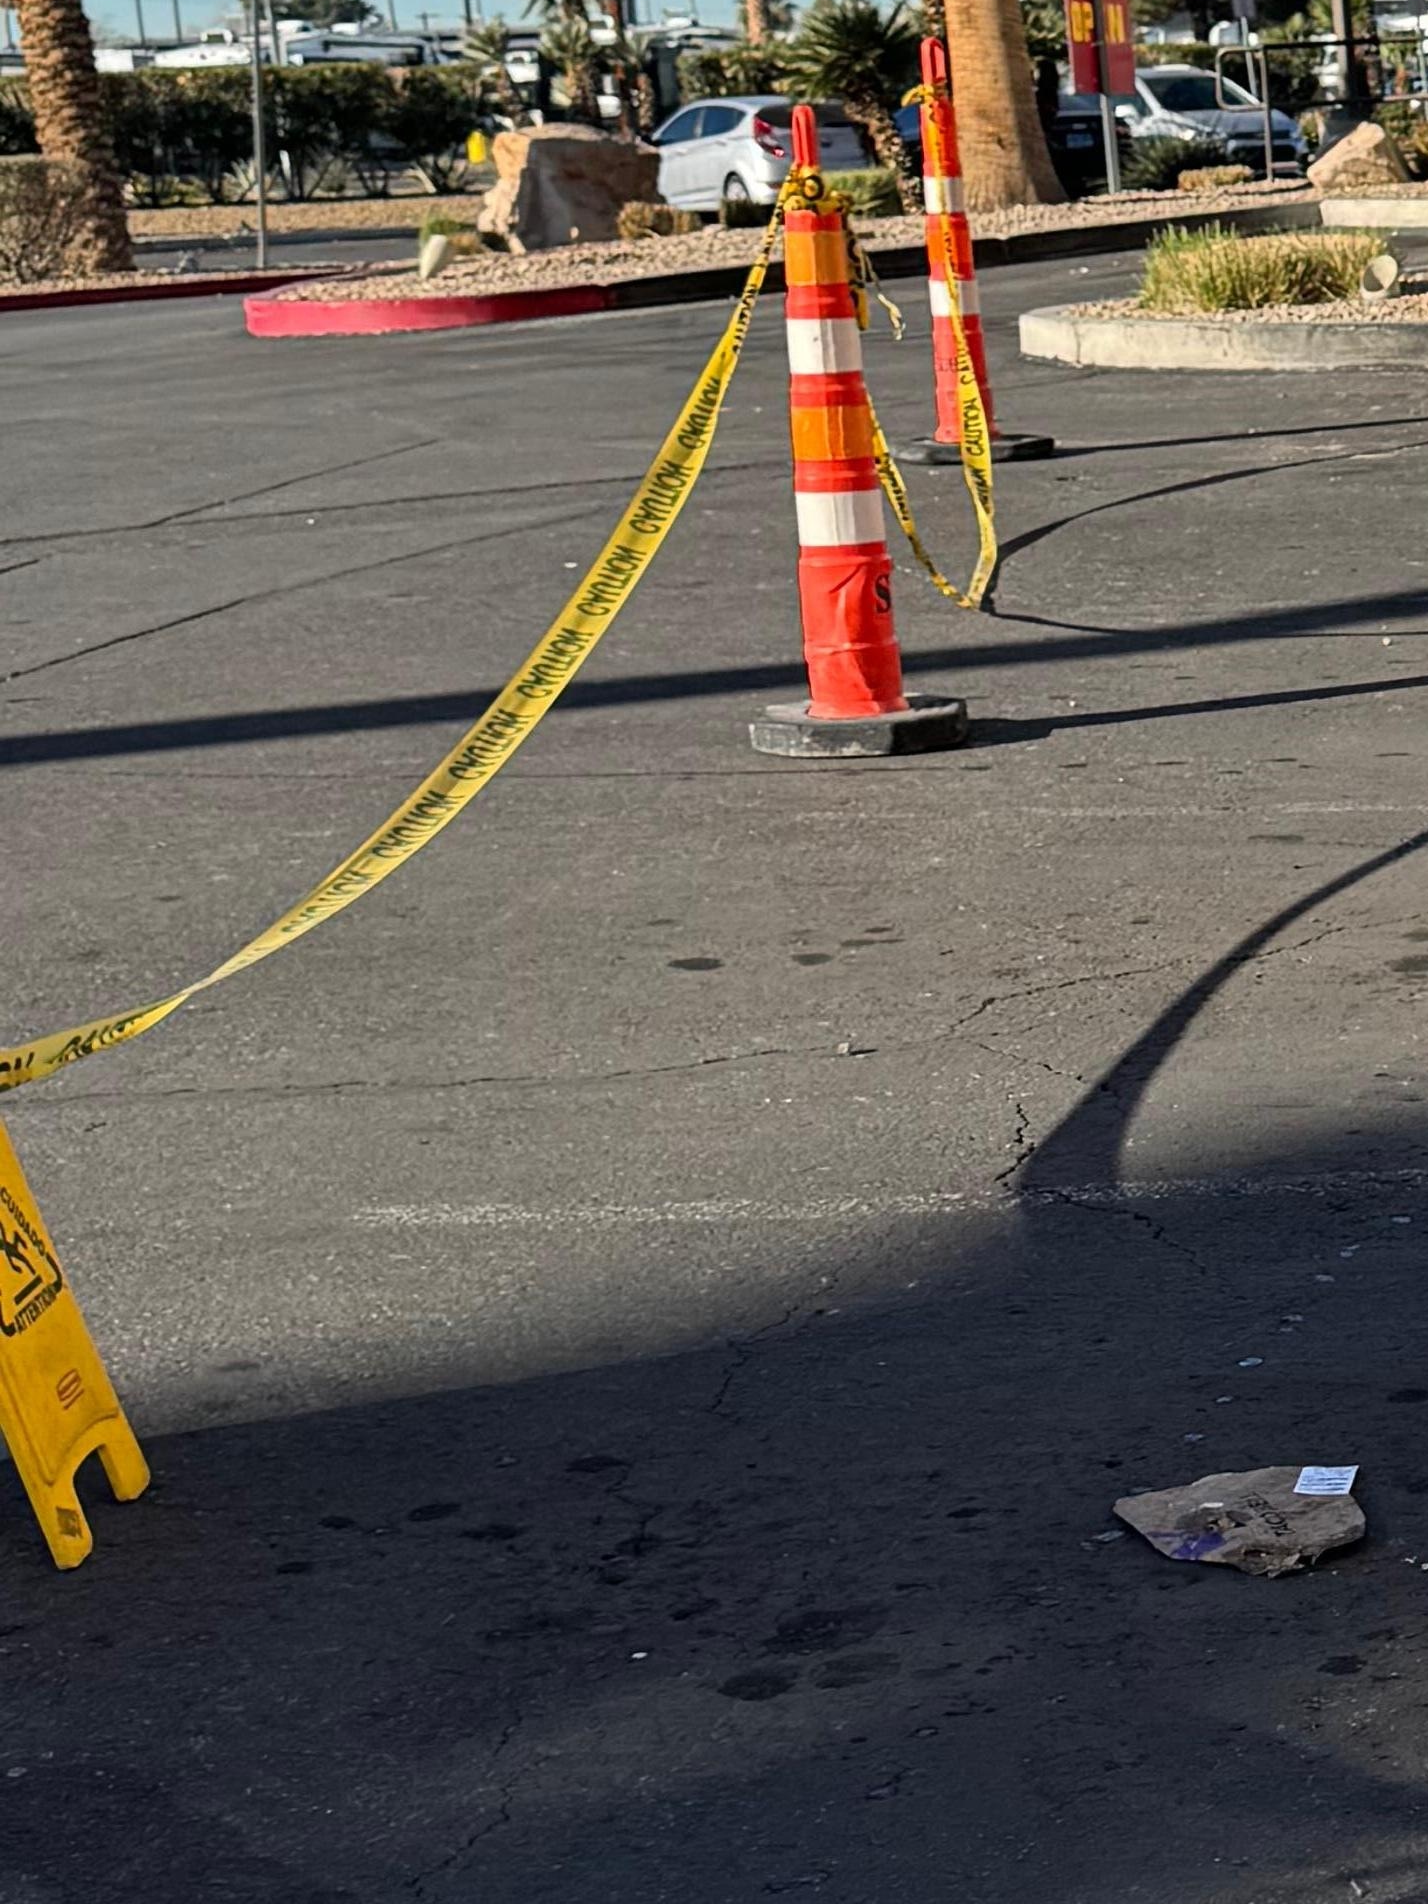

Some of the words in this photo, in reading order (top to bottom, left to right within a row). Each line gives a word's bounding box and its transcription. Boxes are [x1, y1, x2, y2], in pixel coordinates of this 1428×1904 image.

[1070, 0, 1126, 43] OPN
[963, 397, 985, 457] CAUTION
[0, 1186, 46, 1257] CUIDADO
